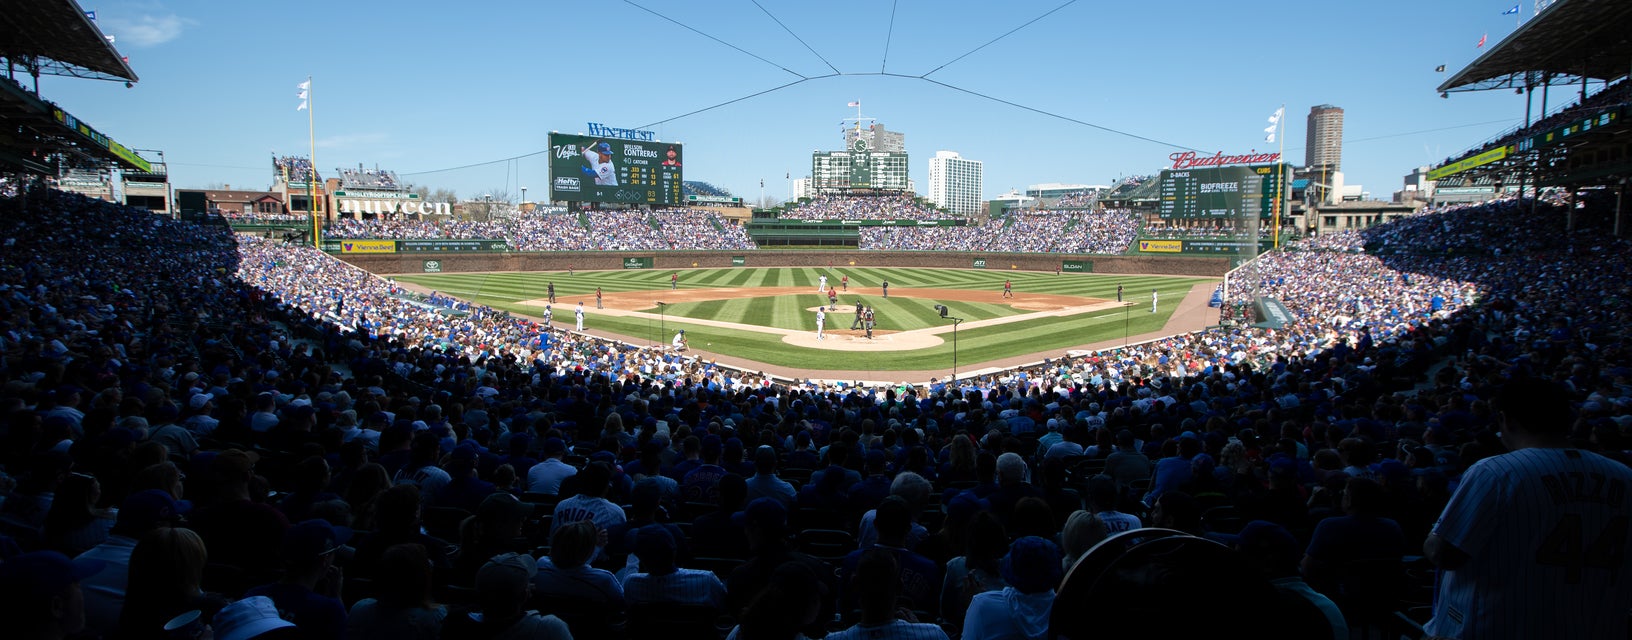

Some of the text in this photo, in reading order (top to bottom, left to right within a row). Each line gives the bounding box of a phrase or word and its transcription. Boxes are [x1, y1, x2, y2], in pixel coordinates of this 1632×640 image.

[588, 122, 655, 141] WINTRUST
[624, 149, 658, 158] CONTRERAS
[1169, 149, 1281, 169] Budweiser
[341, 199, 452, 215] nuveen
